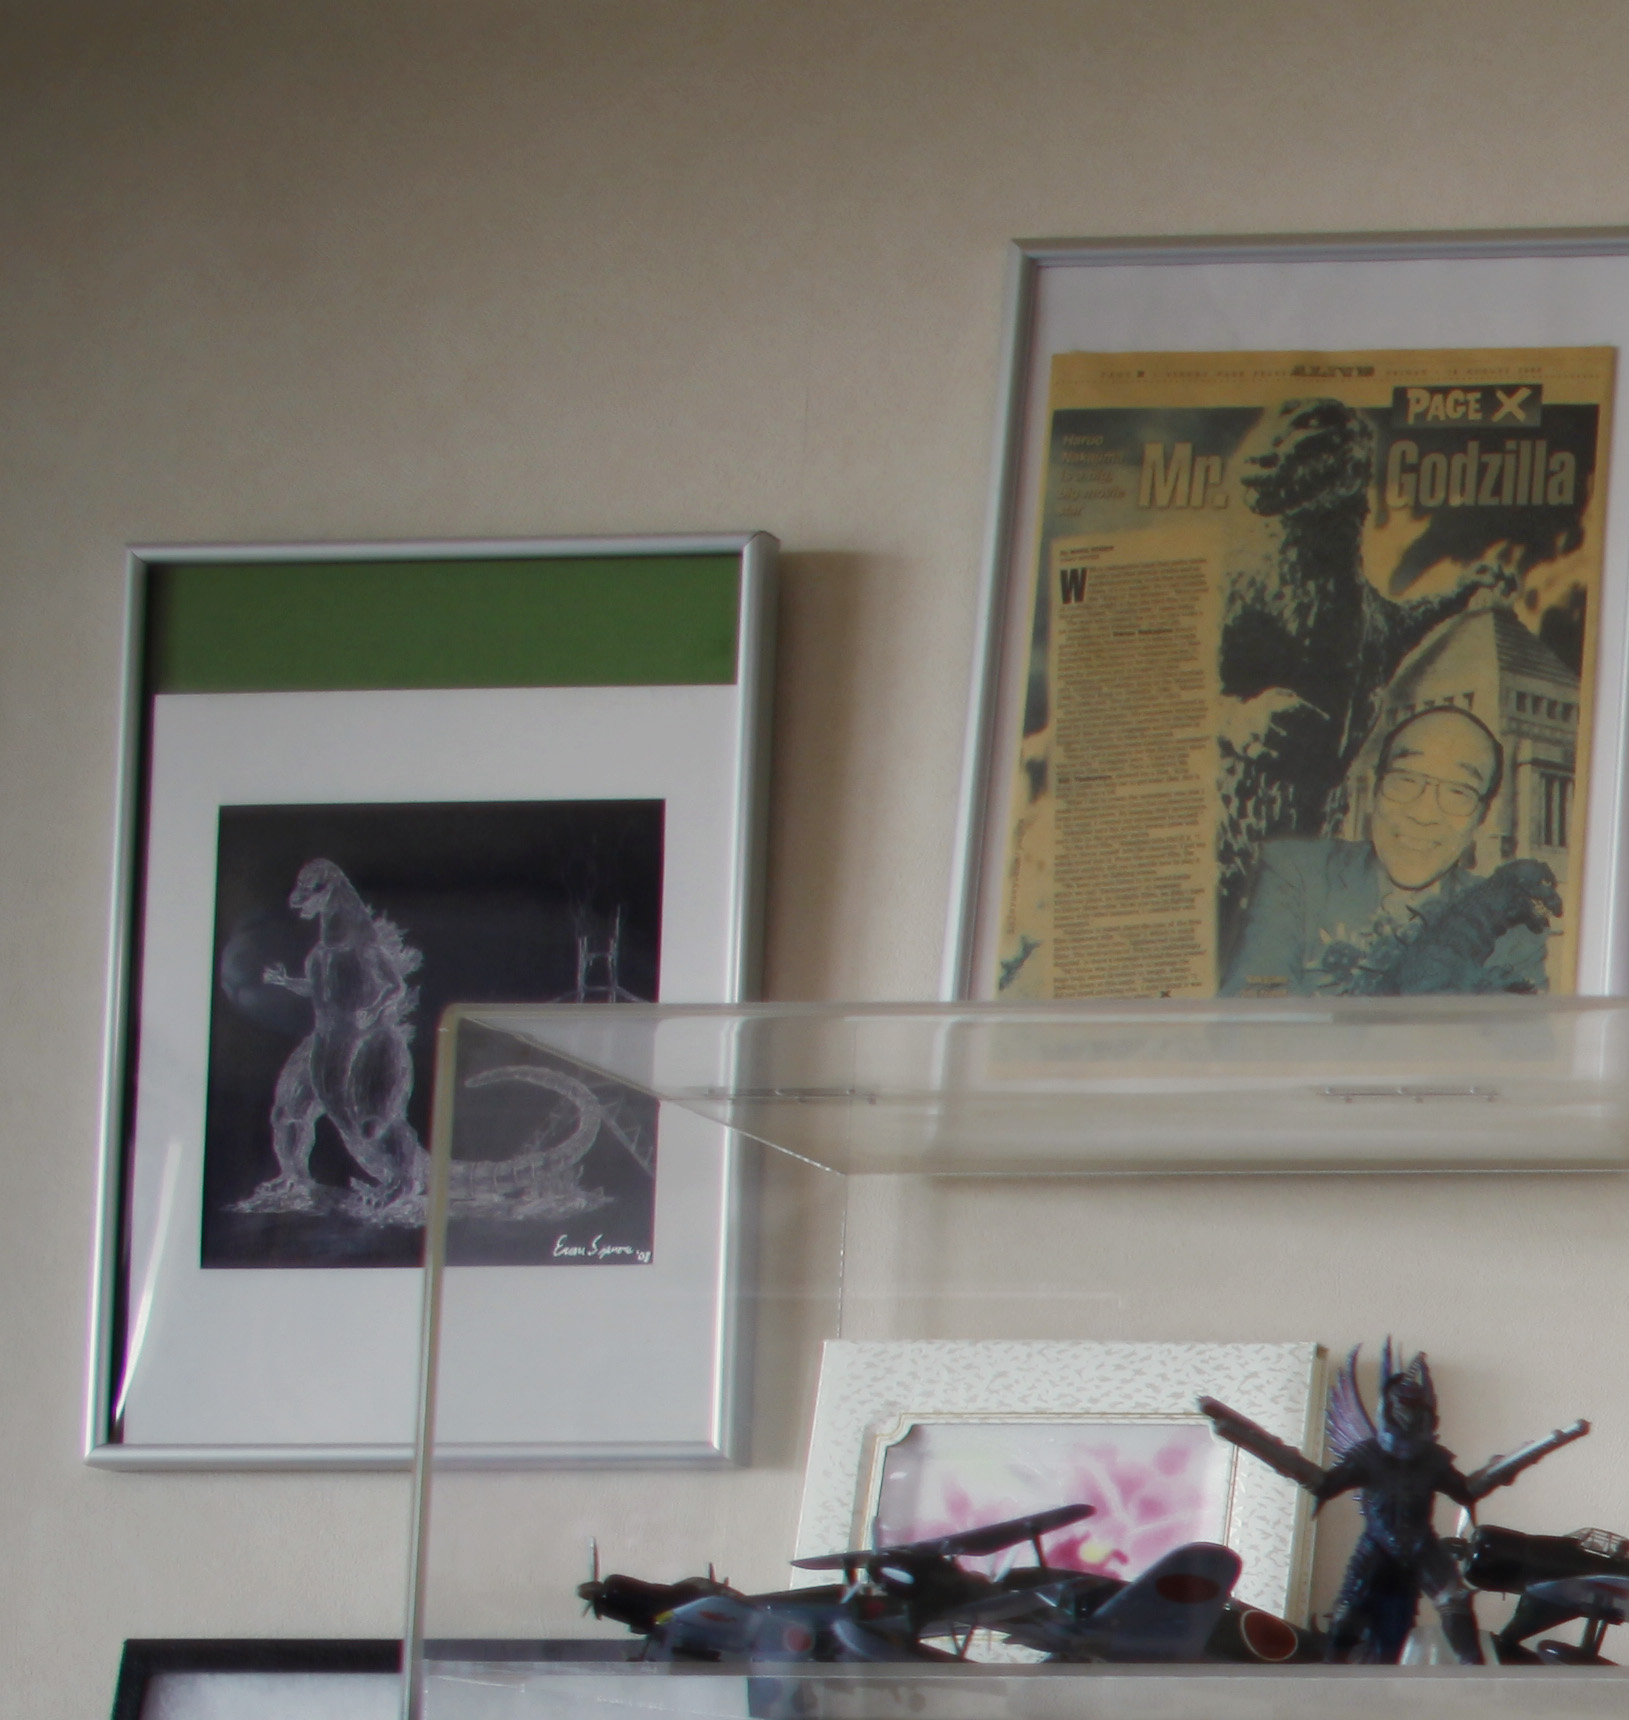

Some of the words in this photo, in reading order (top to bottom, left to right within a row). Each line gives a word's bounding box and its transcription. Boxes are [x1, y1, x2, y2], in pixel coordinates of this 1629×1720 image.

[1406, 387, 1483, 424] PAGE
[1491, 386, 1533, 422] X
[1139, 441, 1230, 509] Mr.
[1386, 438, 1577, 508] Godzilla
